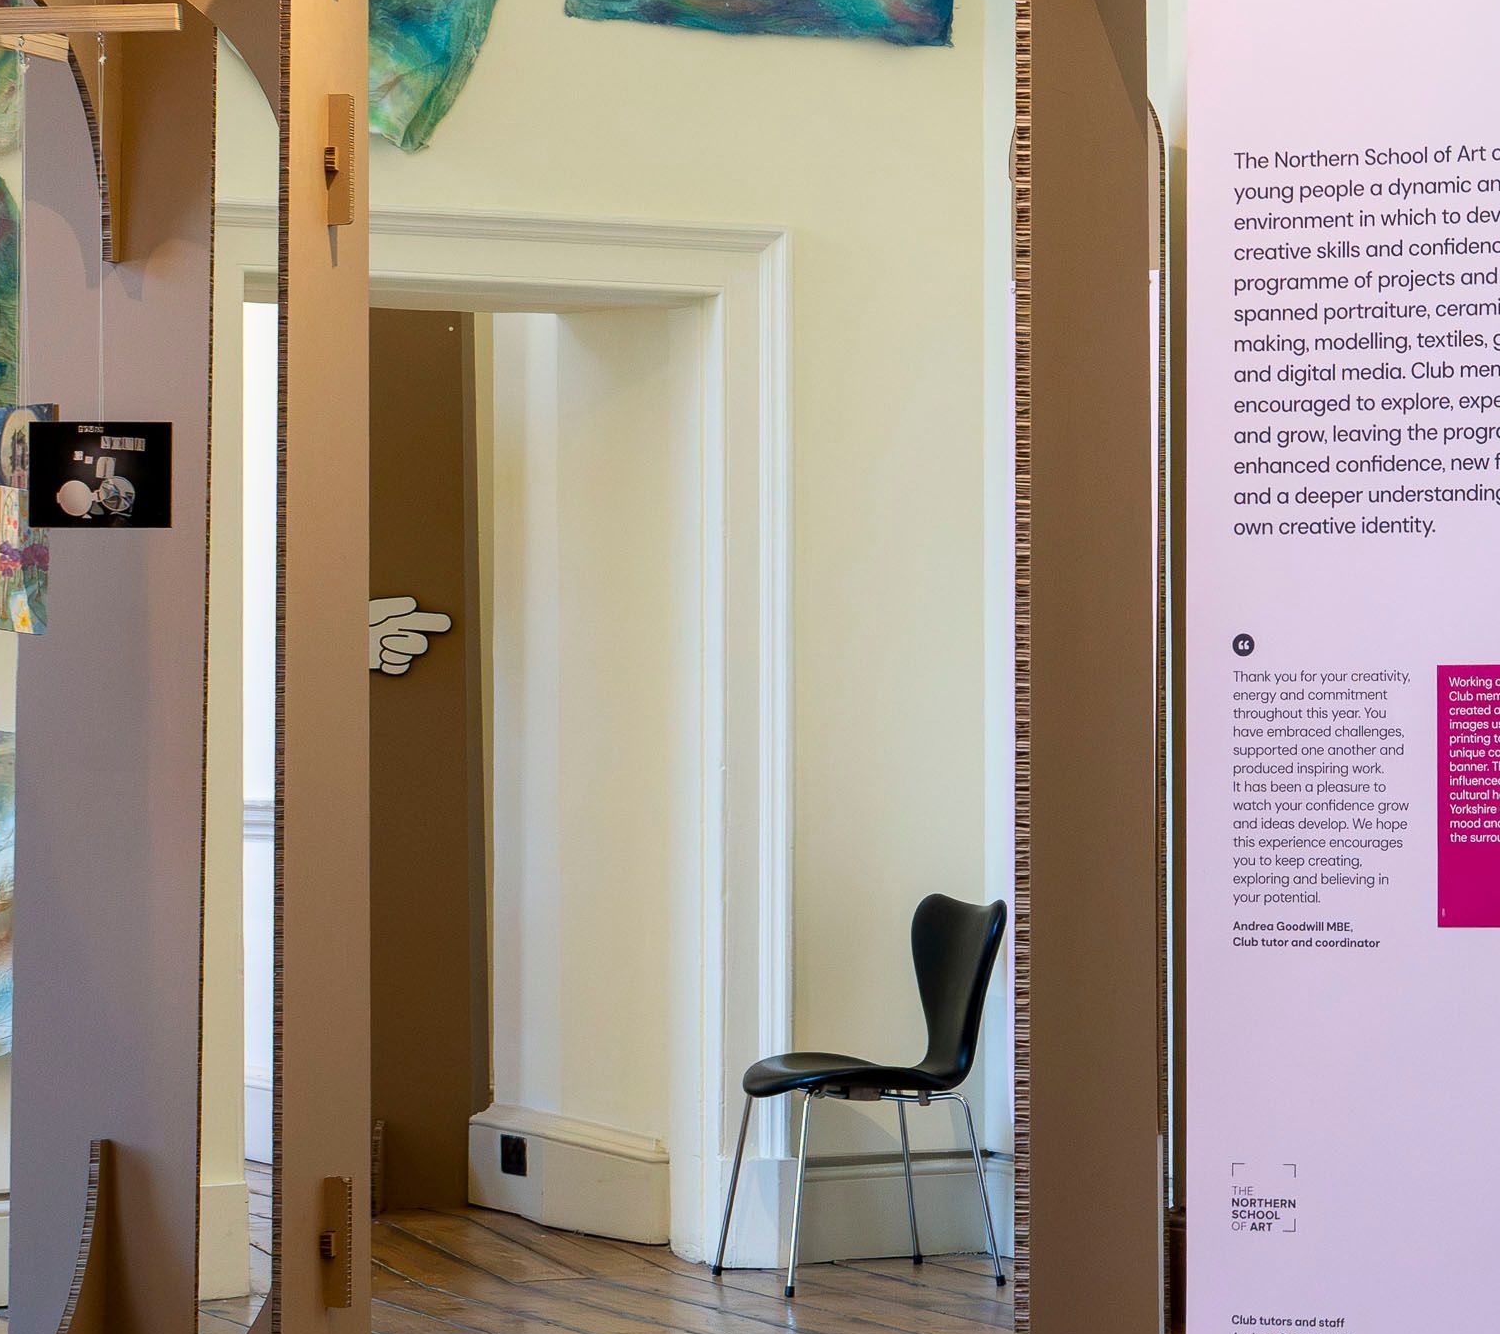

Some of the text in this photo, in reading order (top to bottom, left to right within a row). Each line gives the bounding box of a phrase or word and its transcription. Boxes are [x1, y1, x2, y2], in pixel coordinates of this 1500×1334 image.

[1233, 152, 1269, 169] The
[1275, 150, 1359, 168] Northern
[1364, 146, 1428, 166] School
[1433, 145, 1452, 163] of
[1457, 145, 1487, 162] Art
[1234, 186, 1294, 205] young
[1299, 179, 1365, 203] people
[1370, 183, 1382, 196] a
[1388, 175, 1472, 200] dynamic
[1234, 212, 1354, 231] environment
[1359, 210, 1375, 227] in
[1380, 207, 1436, 226] which
[1441, 209, 1461, 224] to
[1233, 669, 1411, 685] Thank you for your creativity,
[1448, 676, 1493, 690] Working
[1448, 690, 1474, 702] Club
[1232, 921, 1353, 933] Andrea Goodwill MBE,
[1231, 1185, 1254, 1196] THE
[1231, 1197, 1296, 1209] NORTHERN
[1231, 1209, 1281, 1220] SCHOOL
[1231, 1221, 1273, 1232] OF ART
[1231, 1314, 1345, 1328] Club tutors and staff
